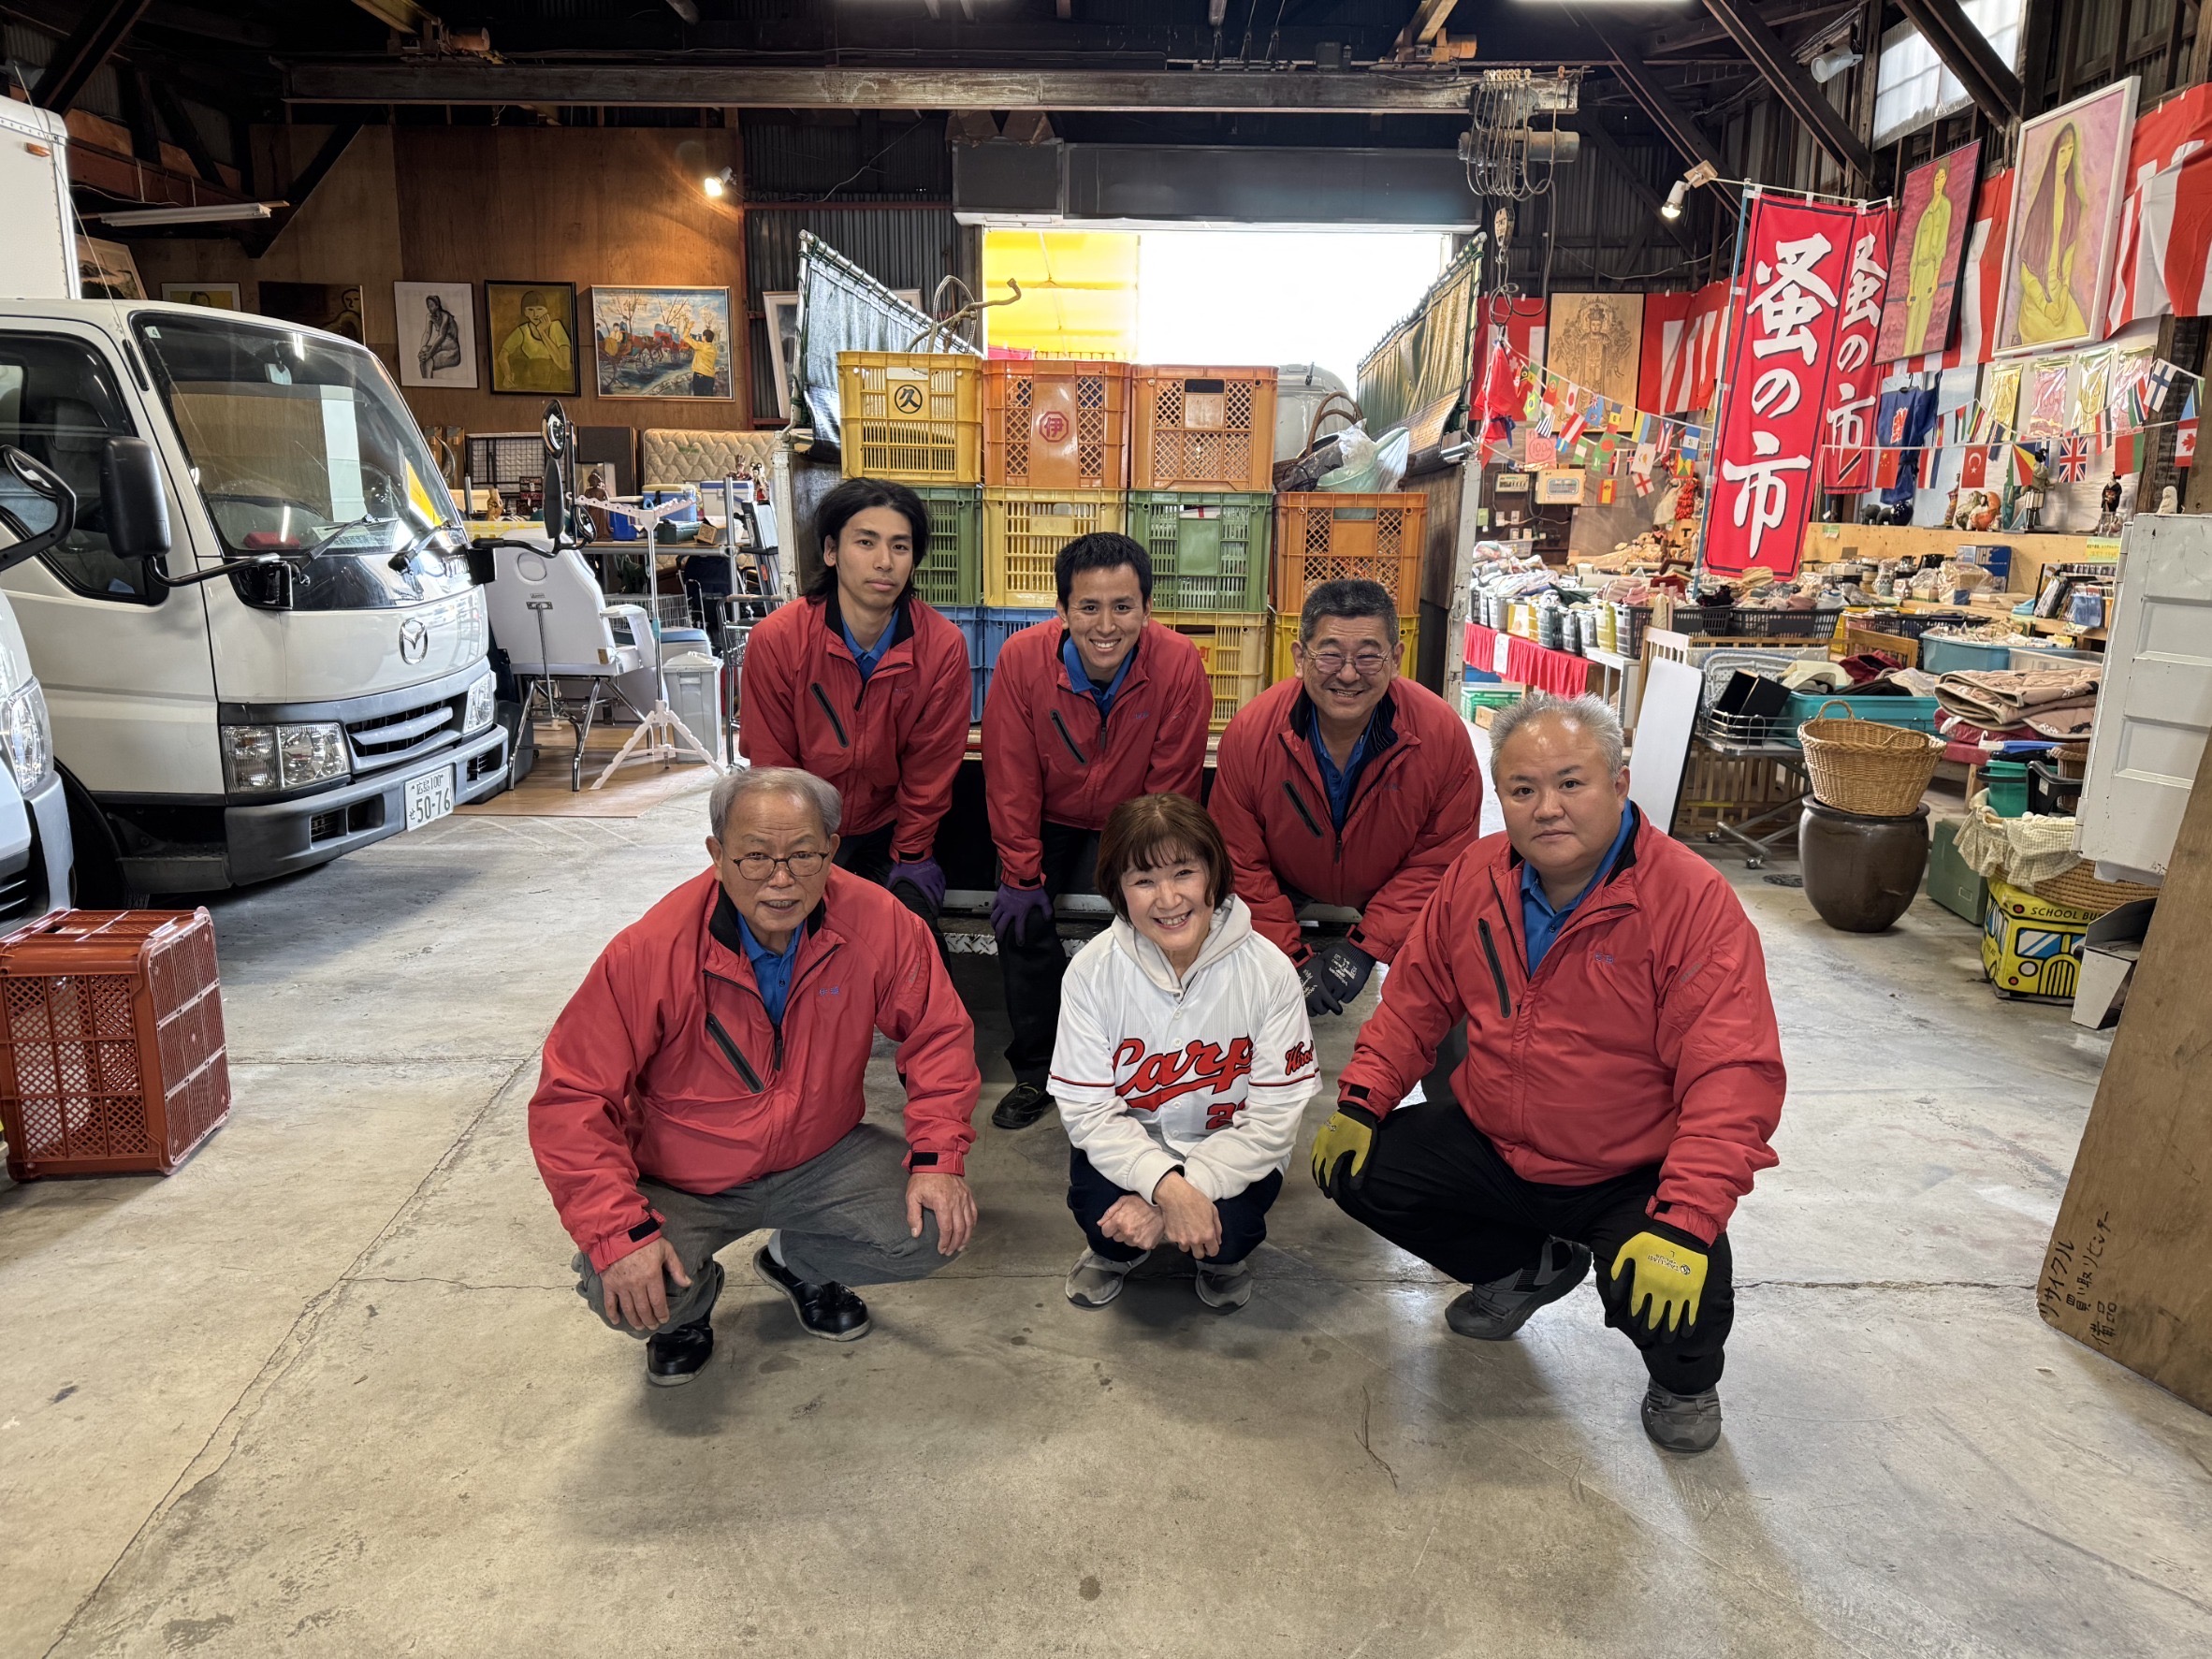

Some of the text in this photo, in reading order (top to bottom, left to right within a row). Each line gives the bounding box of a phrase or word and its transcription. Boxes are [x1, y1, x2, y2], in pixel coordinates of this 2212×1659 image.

[898, 387, 921, 409] 久
[1722, 232, 1839, 560] 蚤の市
[1043, 416, 1065, 438] 伊
[416, 779, 430, 795] 広島
[415, 788, 451, 823] 50-76
[2030, 906, 2078, 920] SCHOOL
[1113, 1035, 1254, 1099] Carp
[2038, 1240, 2075, 1318] リサイクル
[2088, 1300, 2118, 1346] 備品
